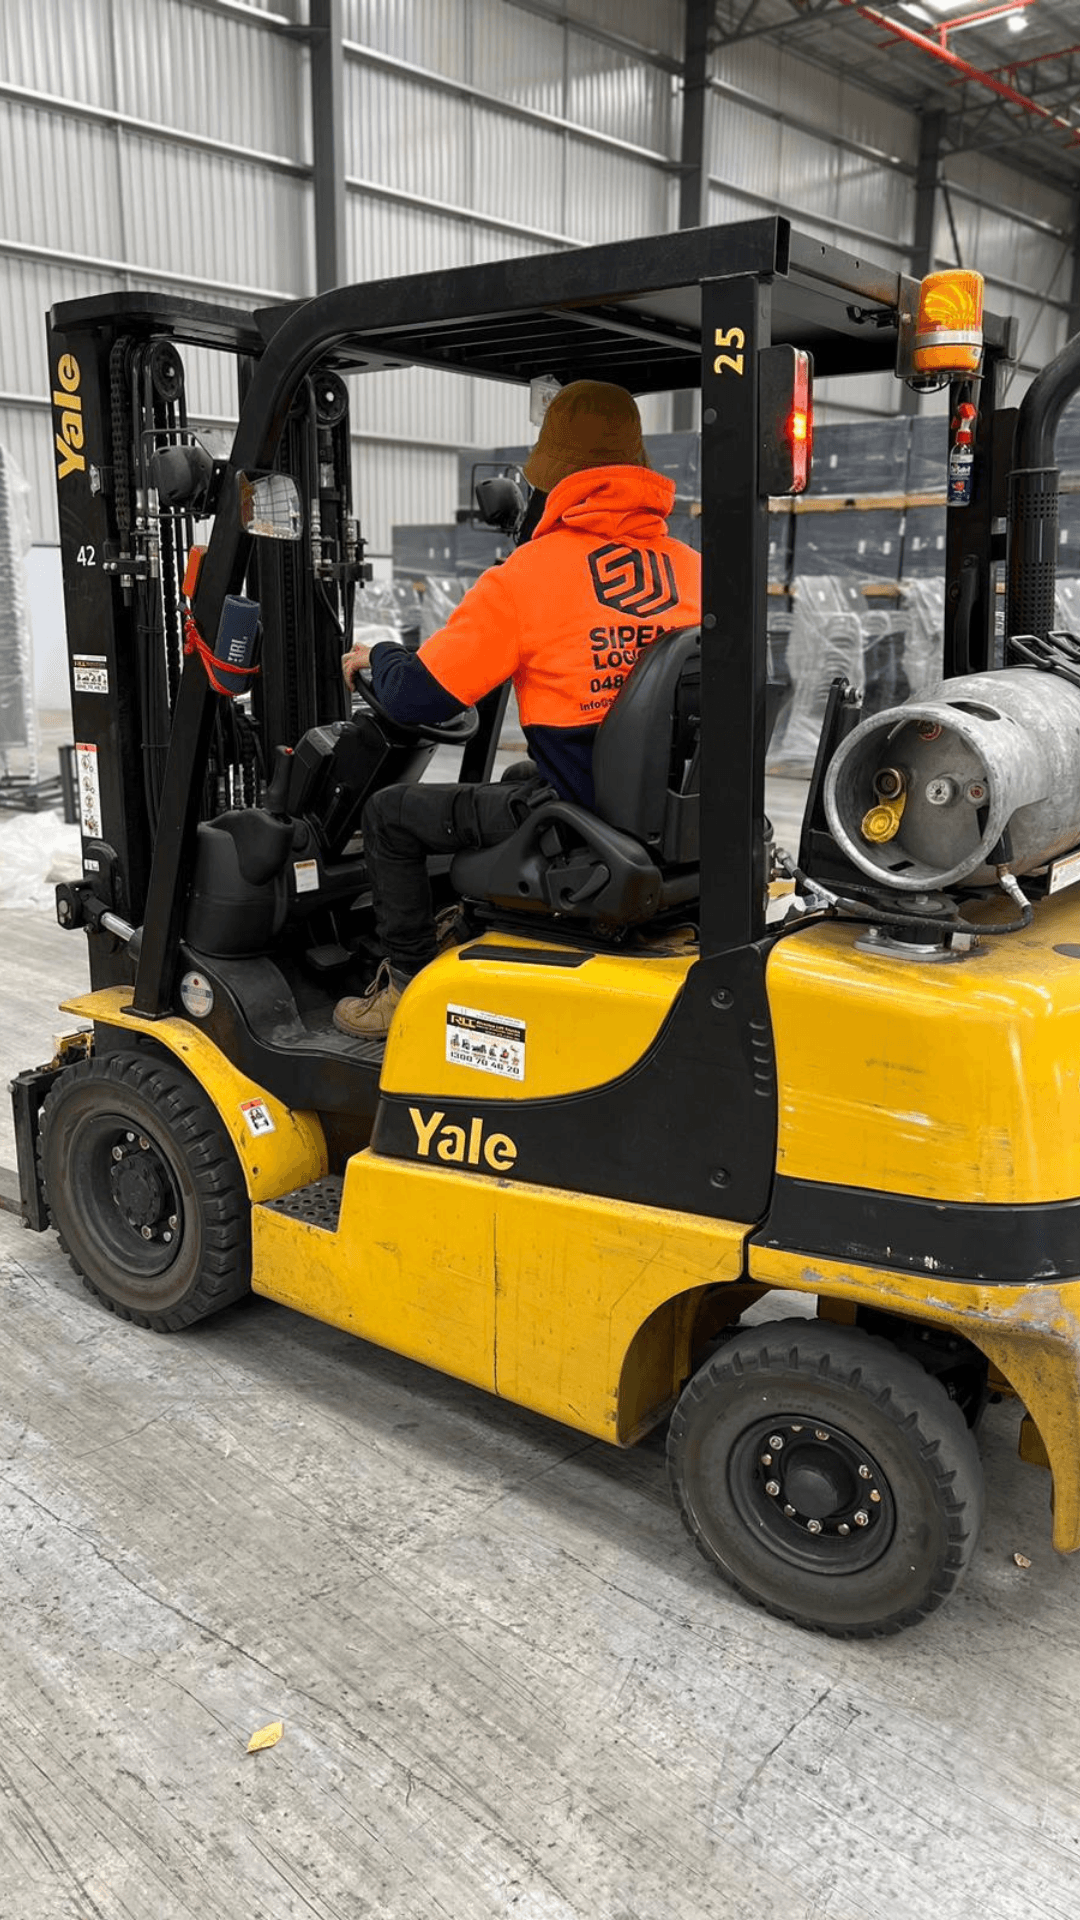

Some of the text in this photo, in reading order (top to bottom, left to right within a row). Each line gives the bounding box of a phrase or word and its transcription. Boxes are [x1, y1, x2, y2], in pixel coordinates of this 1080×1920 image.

[713, 327, 745, 375] 25
[53, 353, 86, 481] Yale
[76, 545, 97, 567] 42
[229, 635, 248, 662] JBL
[450, 1051, 473, 1062] 1300
[408, 1107, 518, 1171] Yale
